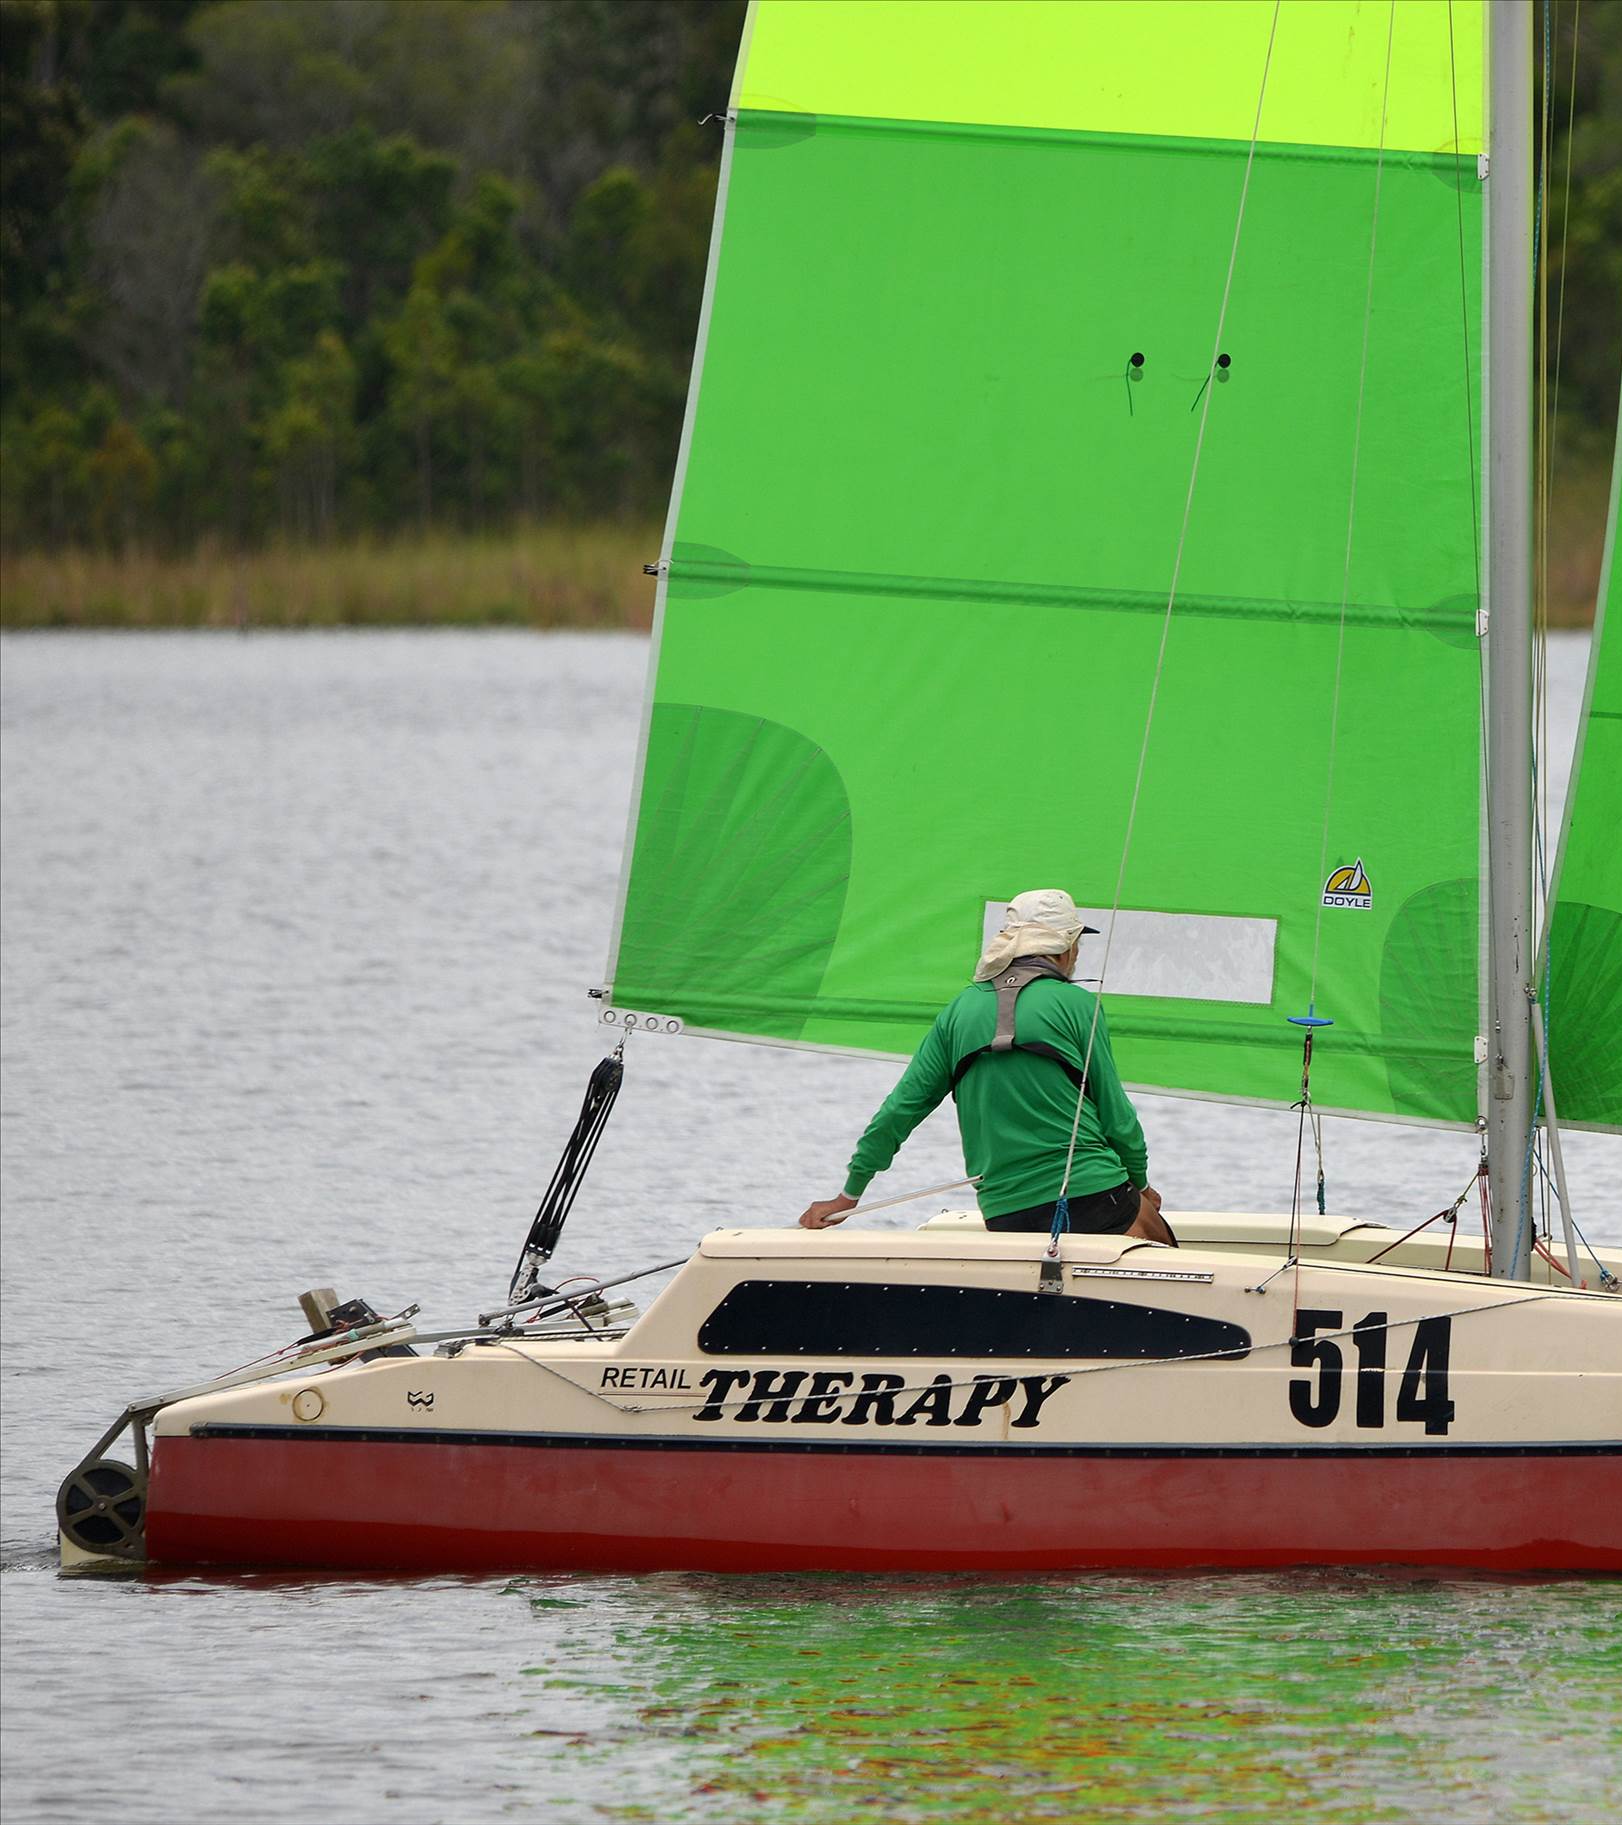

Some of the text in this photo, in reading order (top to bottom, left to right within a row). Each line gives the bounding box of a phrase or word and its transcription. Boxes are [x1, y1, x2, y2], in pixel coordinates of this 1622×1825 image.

[1323, 895, 1371, 909] DOYLE
[600, 1366, 1072, 1429] RETAIL THERAPY
[1288, 1308, 1456, 1436] 514
